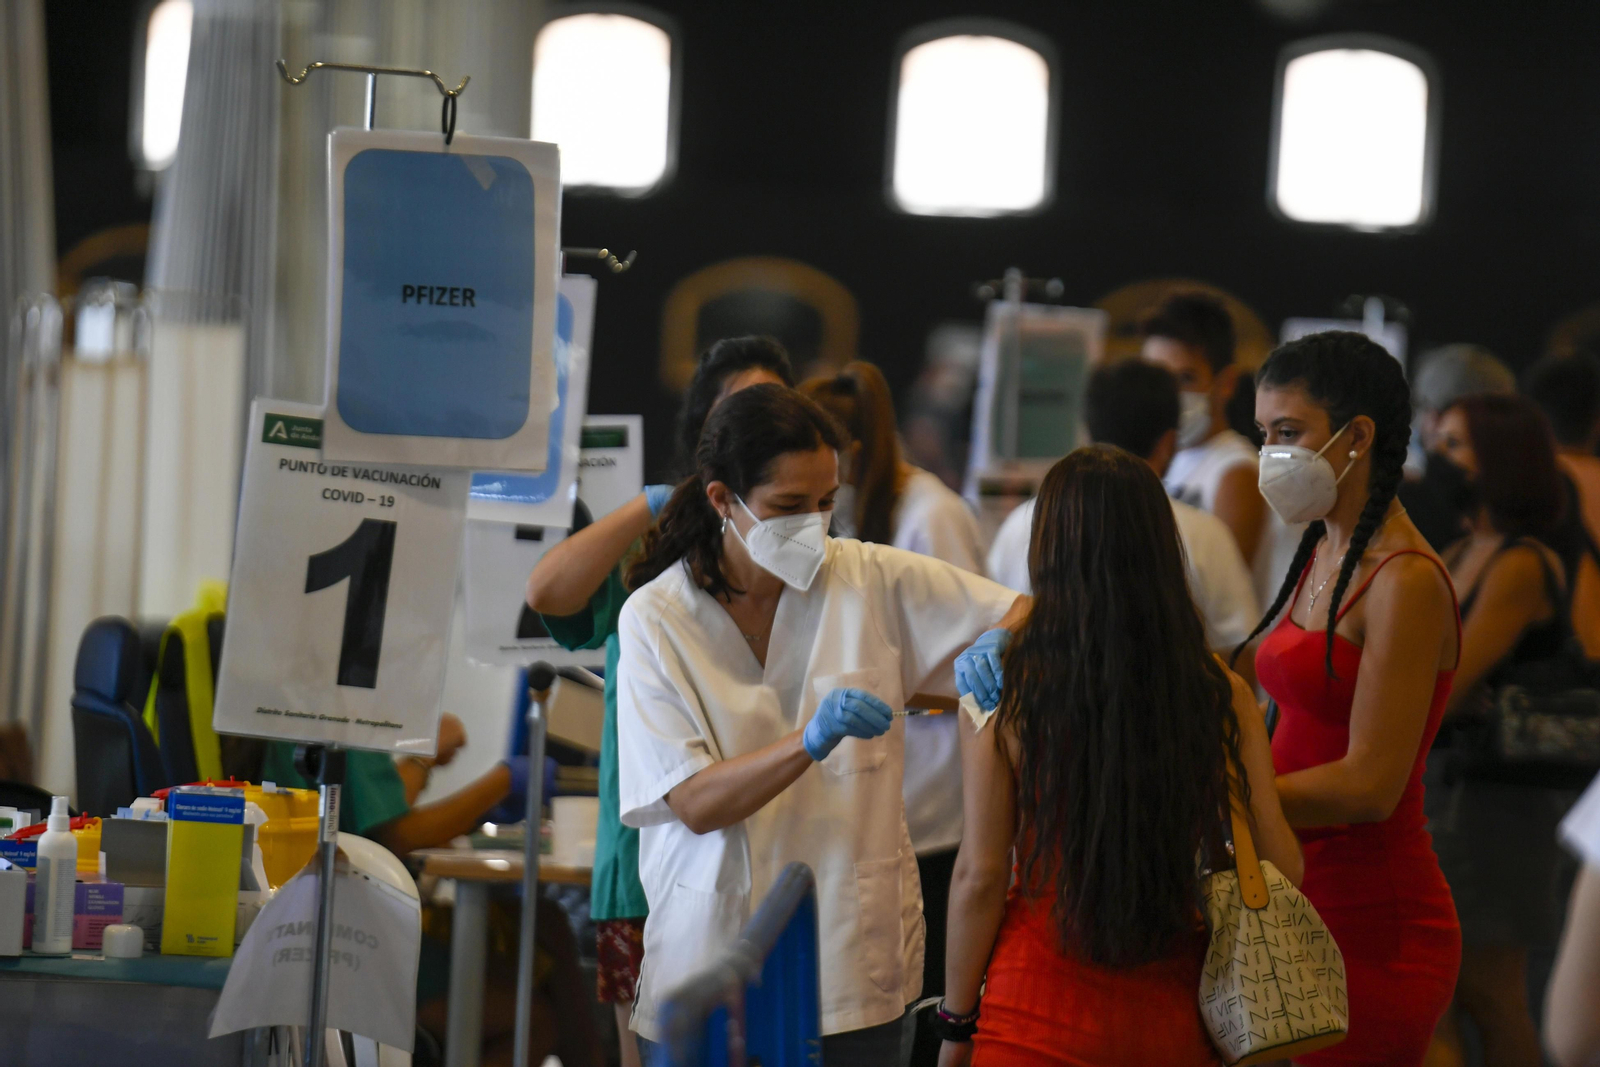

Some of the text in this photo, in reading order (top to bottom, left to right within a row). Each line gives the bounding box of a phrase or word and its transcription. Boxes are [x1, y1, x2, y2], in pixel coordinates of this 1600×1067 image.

[402, 284, 476, 308] PFIZER
[279, 458, 441, 489] PUNTO DE VACUNACIÓN
[322, 488, 364, 503] COVID
[380, 495, 395, 507] 19
[304, 518, 398, 689] 1
[256, 706, 282, 716] Distrito
[284, 710, 316, 719] Sanitario
